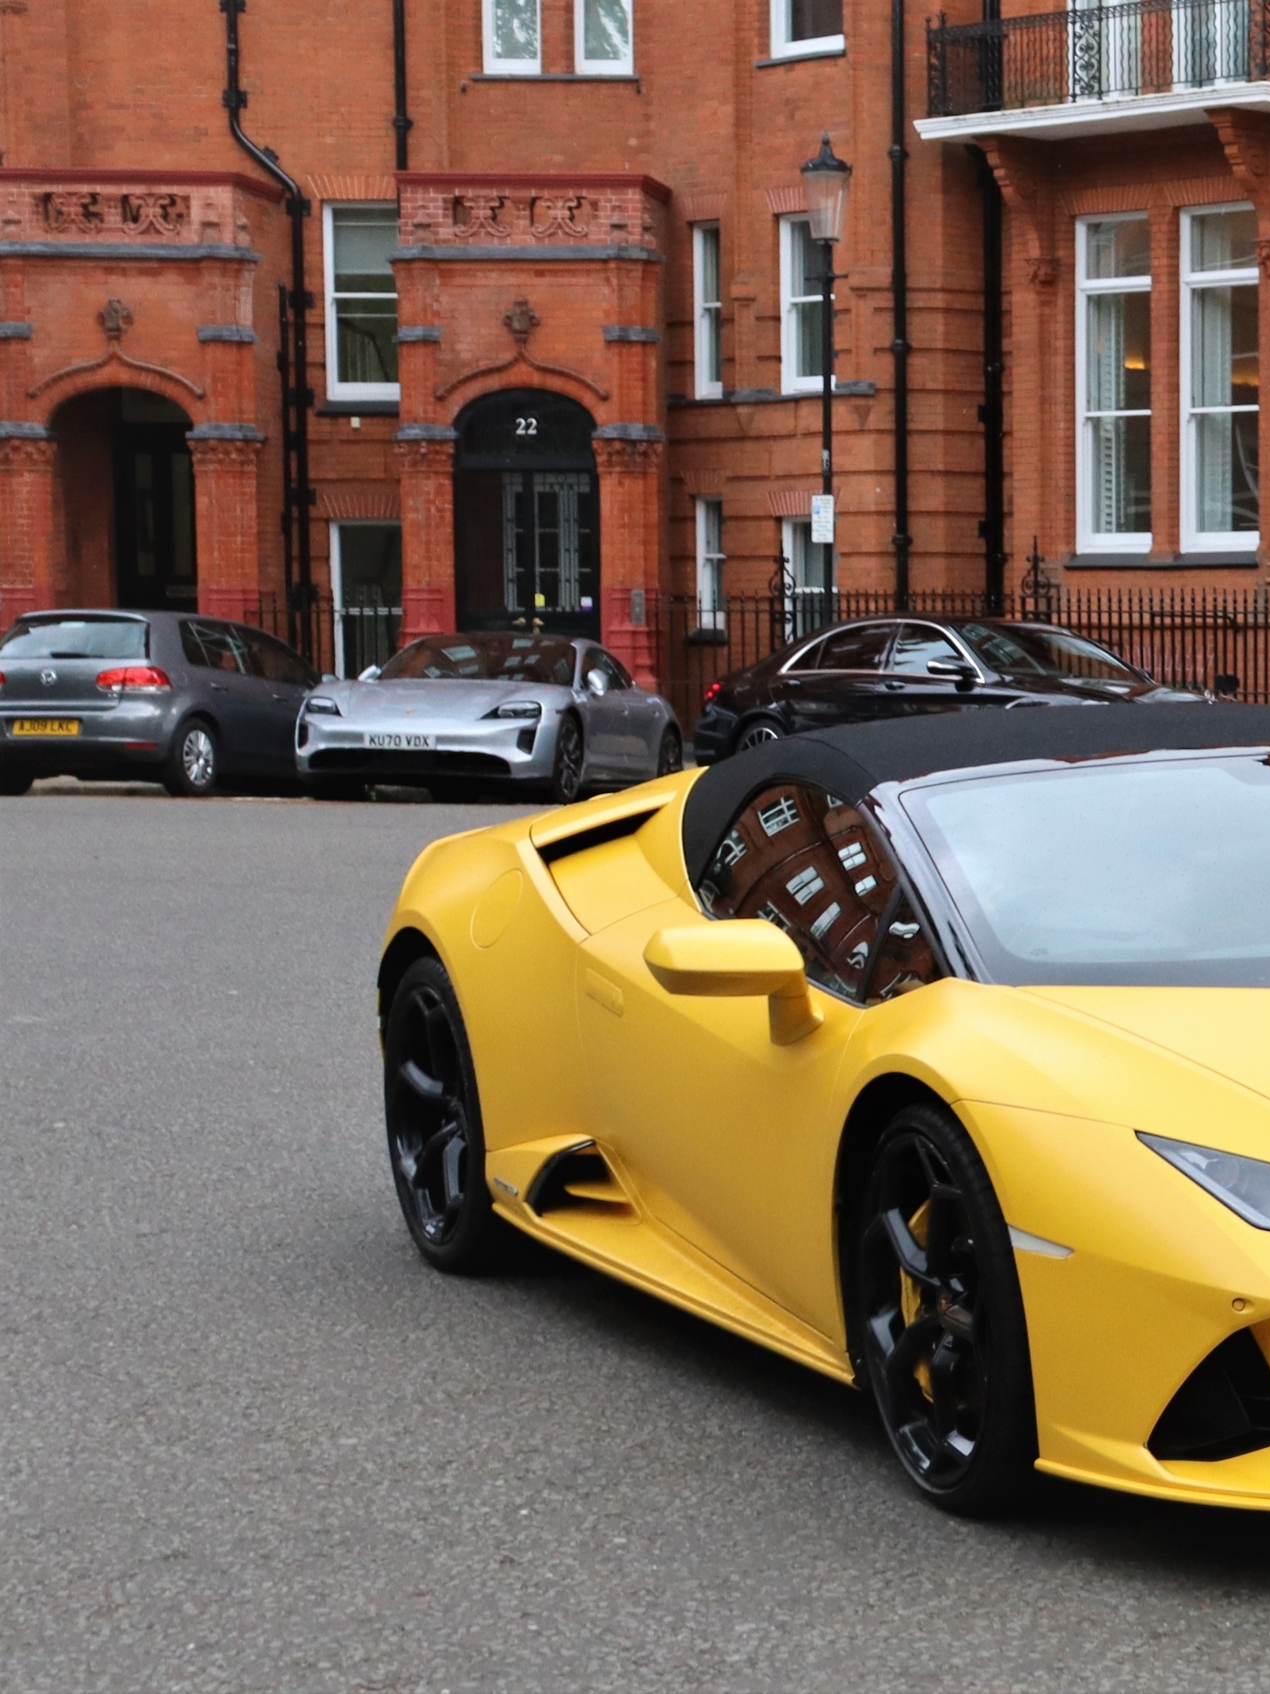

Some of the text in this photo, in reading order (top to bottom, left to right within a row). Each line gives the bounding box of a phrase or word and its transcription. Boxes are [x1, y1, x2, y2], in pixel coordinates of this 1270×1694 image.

[515, 417, 538, 435] 22
[369, 734, 430, 748] KU70 VDX
